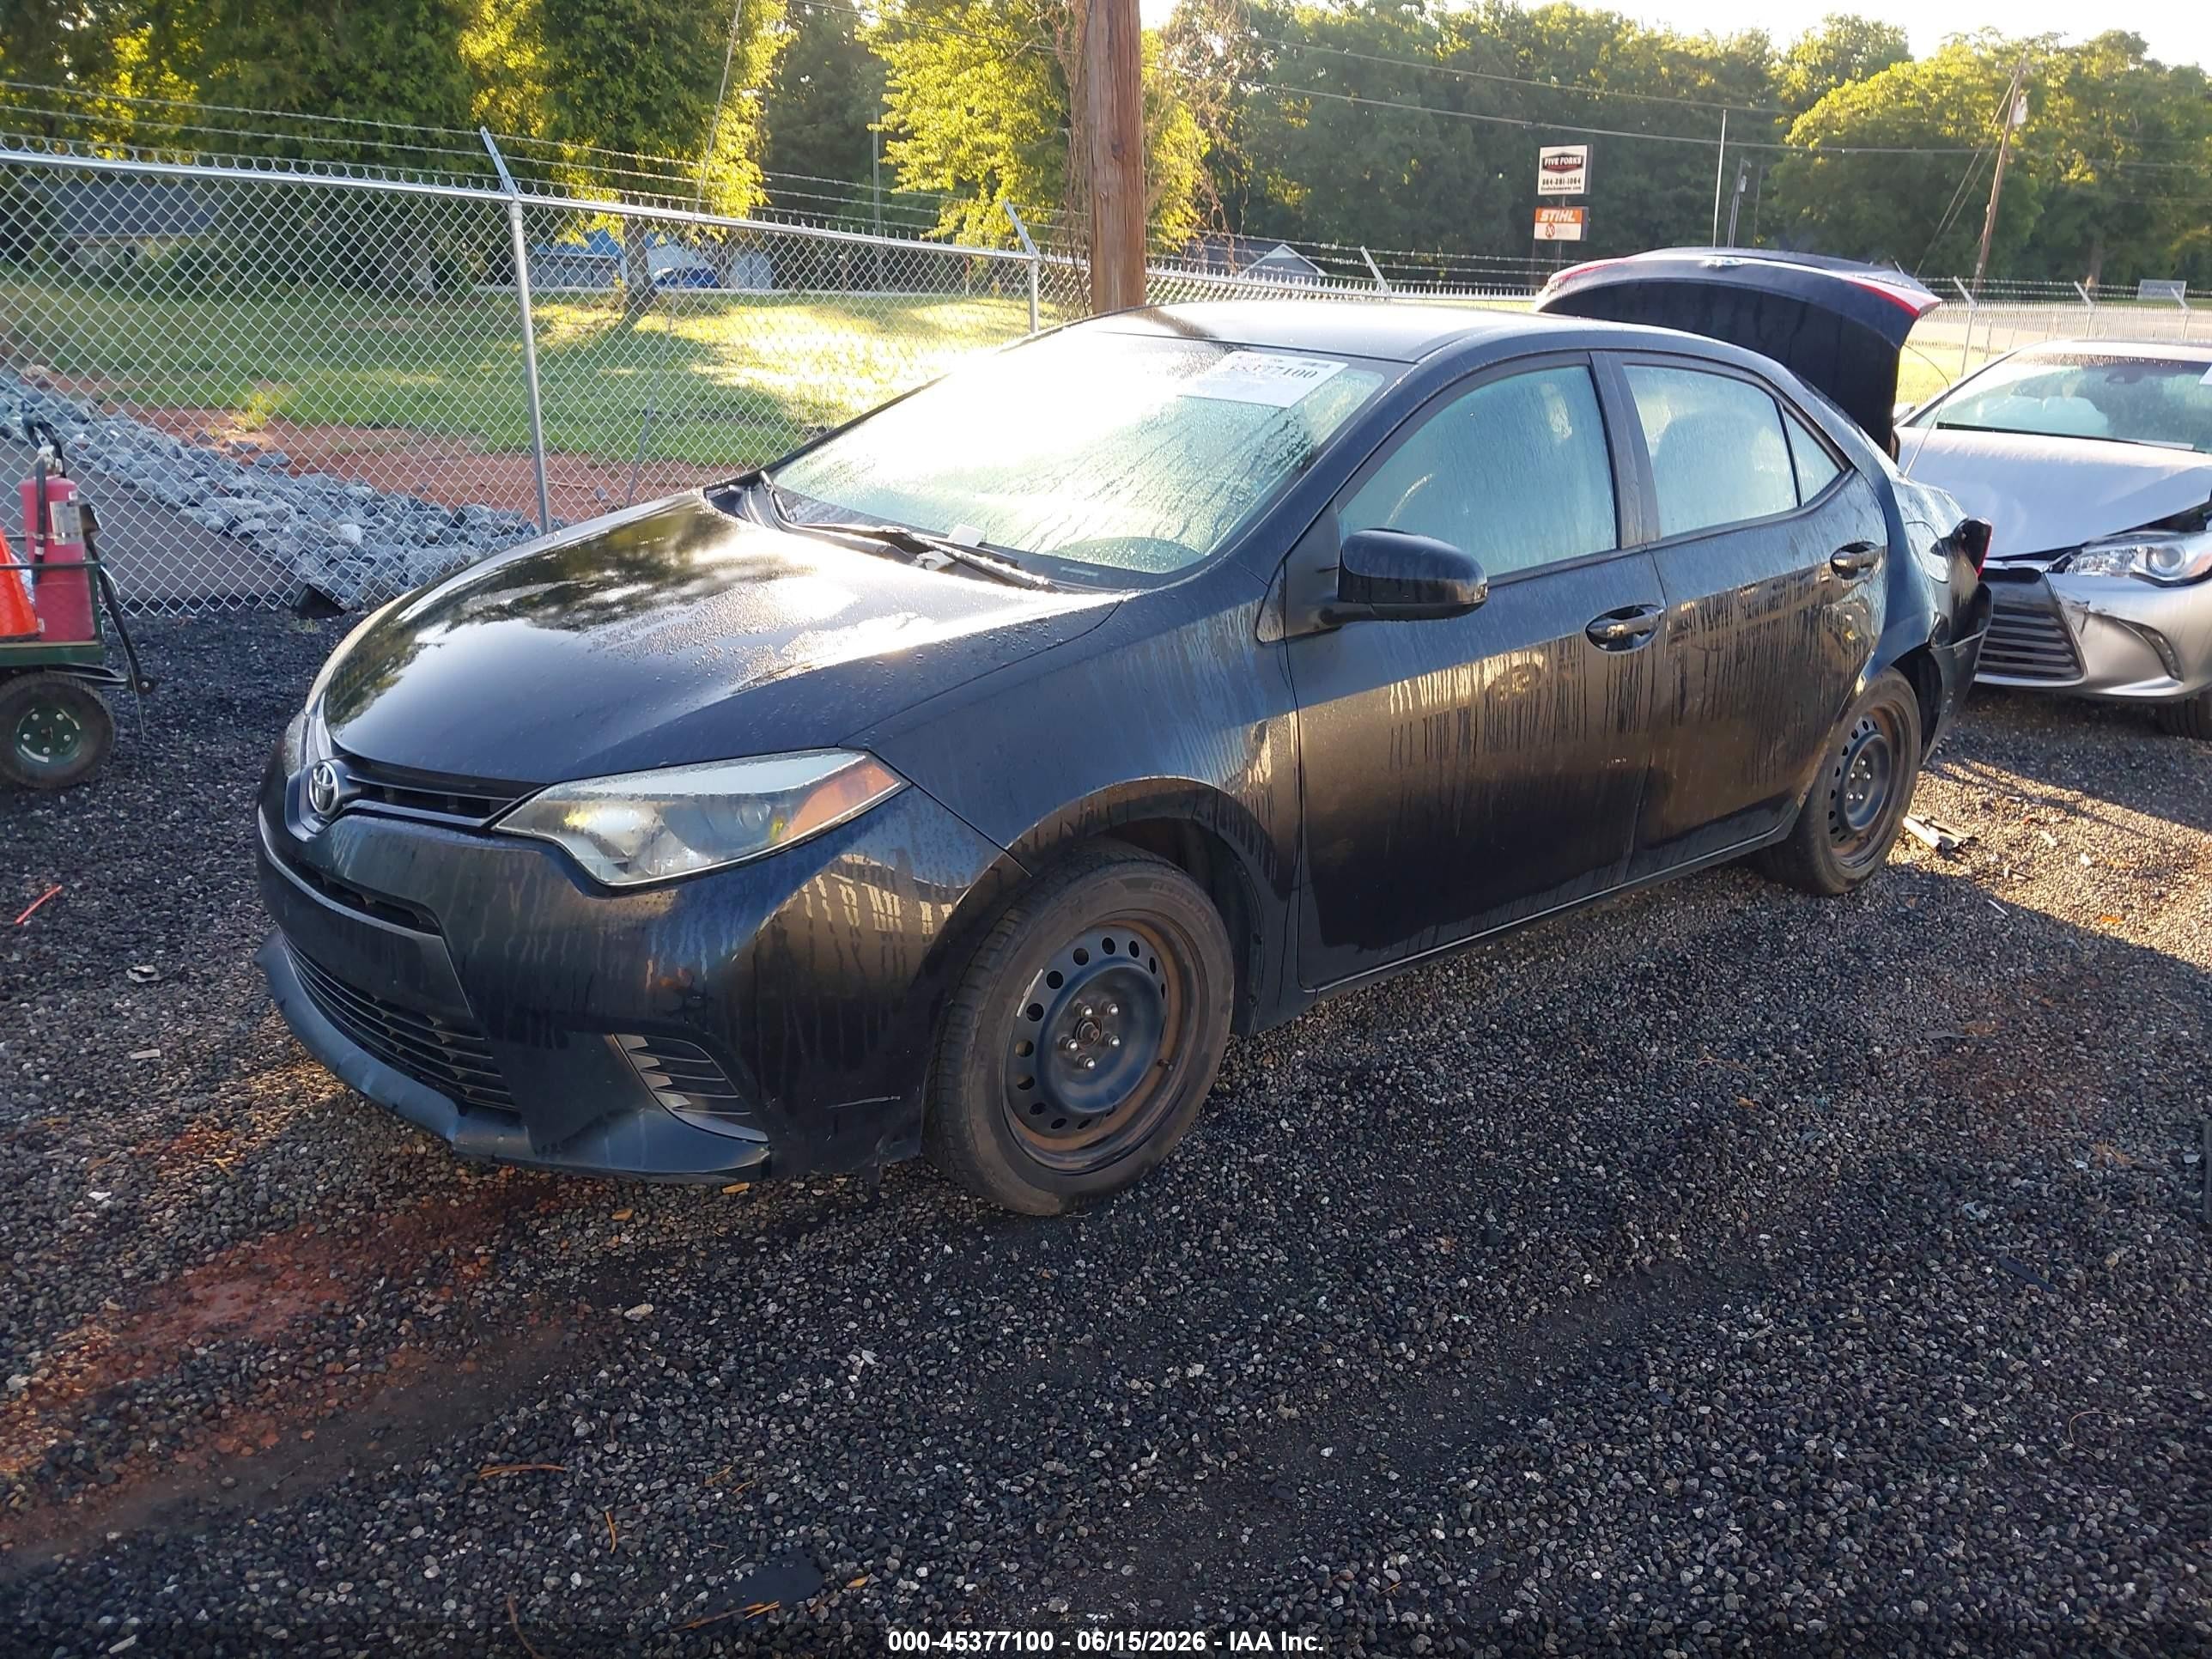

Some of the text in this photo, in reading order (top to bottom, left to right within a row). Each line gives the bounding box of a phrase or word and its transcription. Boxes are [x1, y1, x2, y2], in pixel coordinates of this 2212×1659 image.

[1544, 155, 1582, 166] FIVE FORKS
[1540, 209, 1575, 222] STIHL
